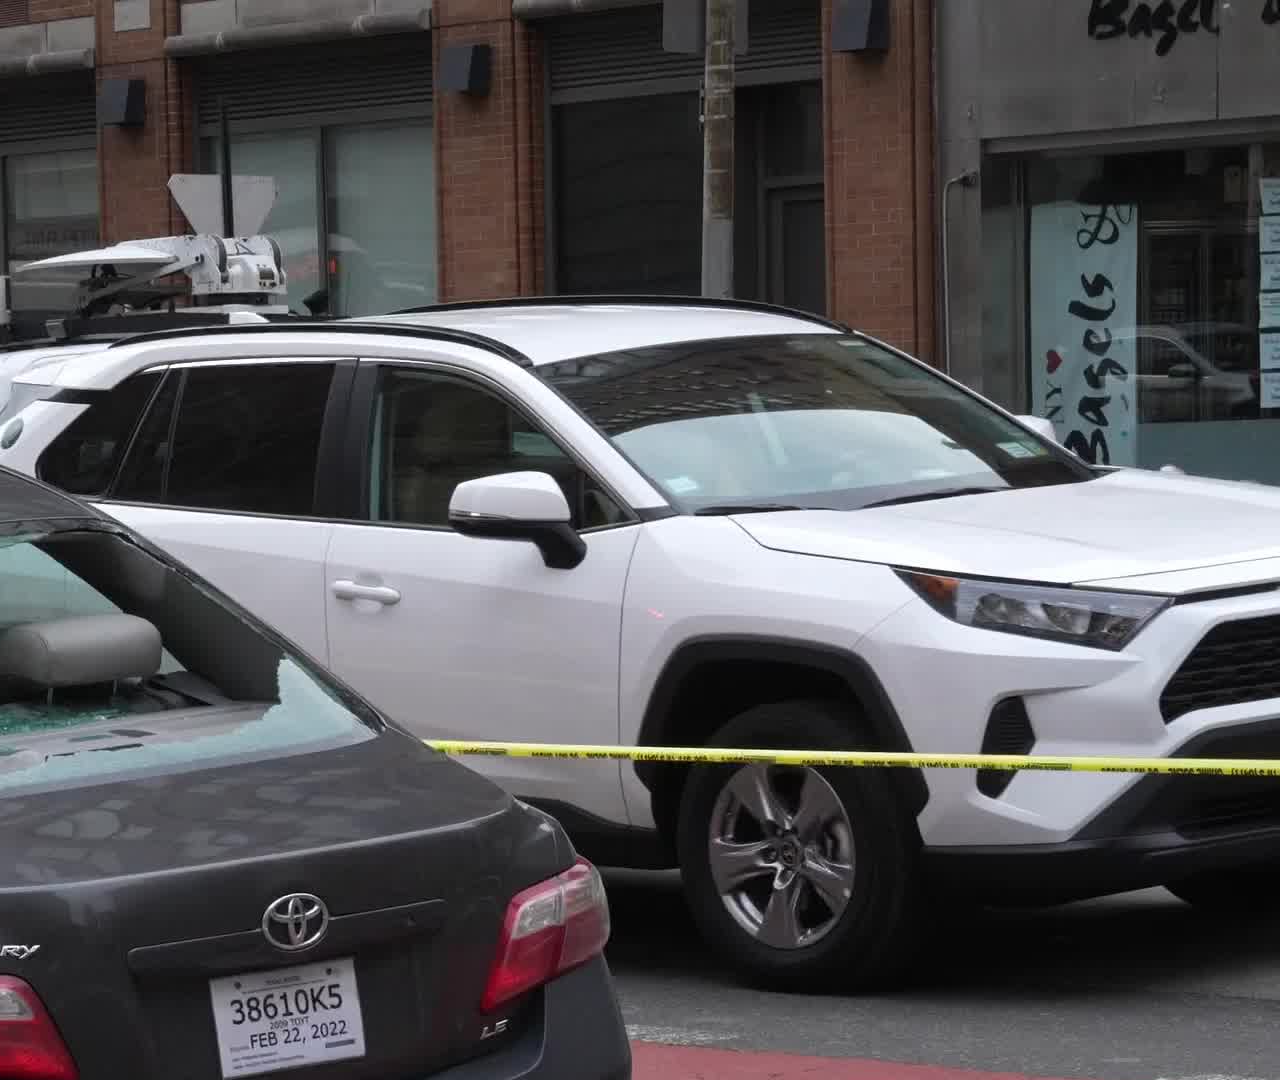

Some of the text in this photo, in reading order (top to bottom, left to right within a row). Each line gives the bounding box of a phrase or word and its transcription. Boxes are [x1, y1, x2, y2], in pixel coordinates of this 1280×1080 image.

[230, 983, 343, 1025] 38610K5
[250, 1020, 347, 1049] FEB 22, 2022
[480, 1019, 508, 1040] LE
